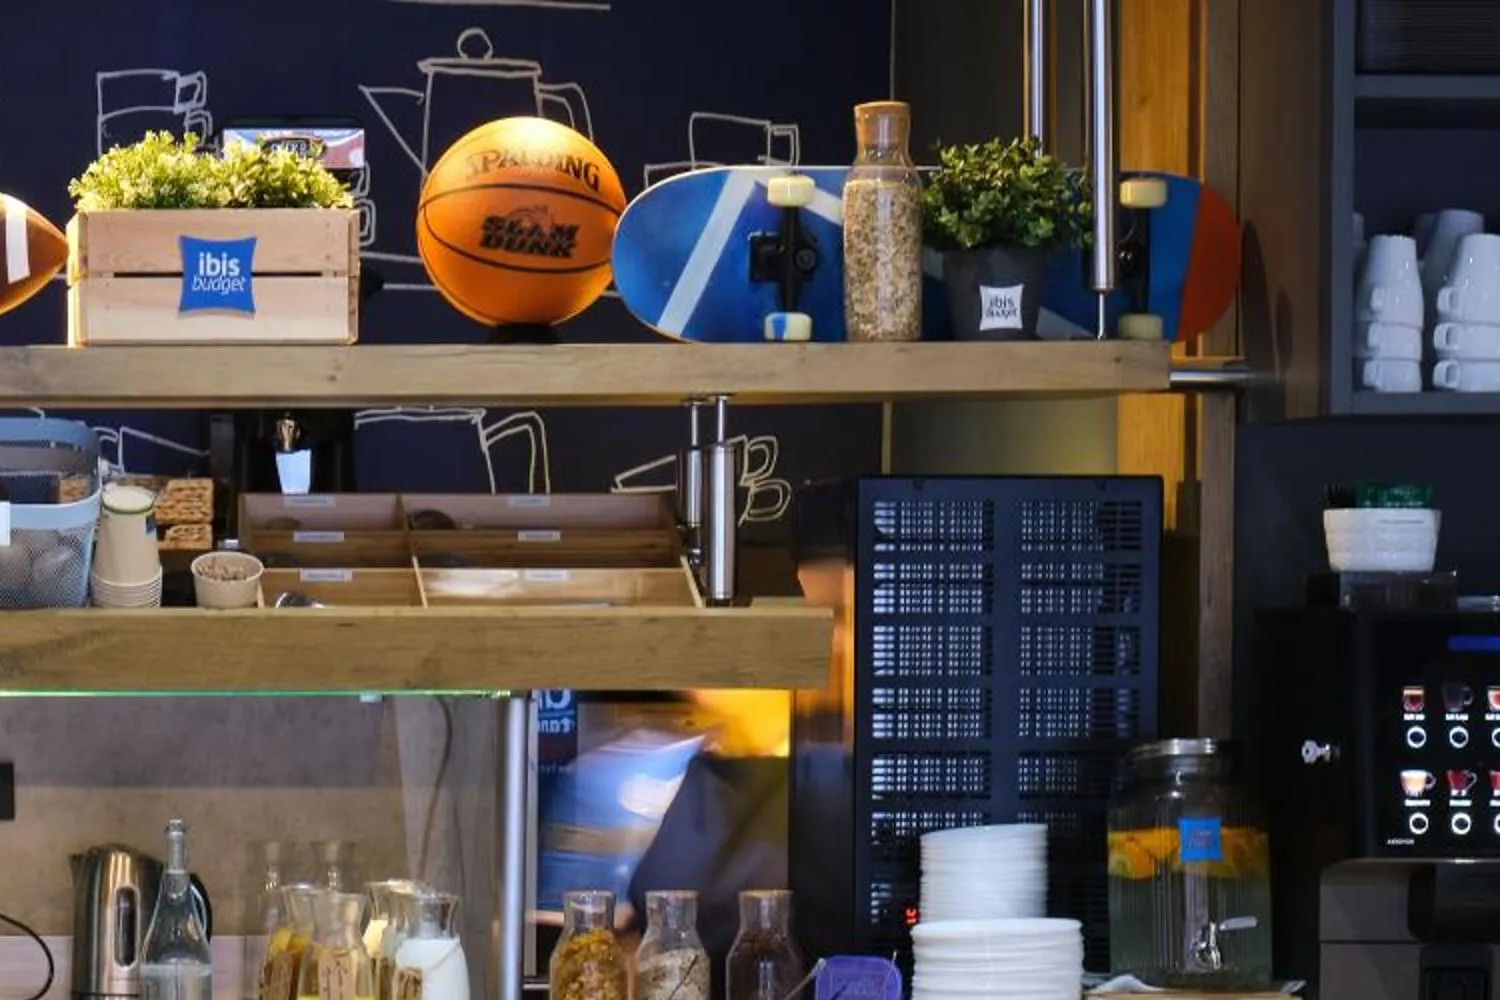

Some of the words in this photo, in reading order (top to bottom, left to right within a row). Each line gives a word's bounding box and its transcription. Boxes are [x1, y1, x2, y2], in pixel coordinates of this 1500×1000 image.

[466, 148, 600, 192] SPALDING
[485, 213, 580, 240] SLAM
[479, 231, 574, 259] DUNK
[198, 251, 241, 276] ibis
[191, 275, 246, 295] budget
